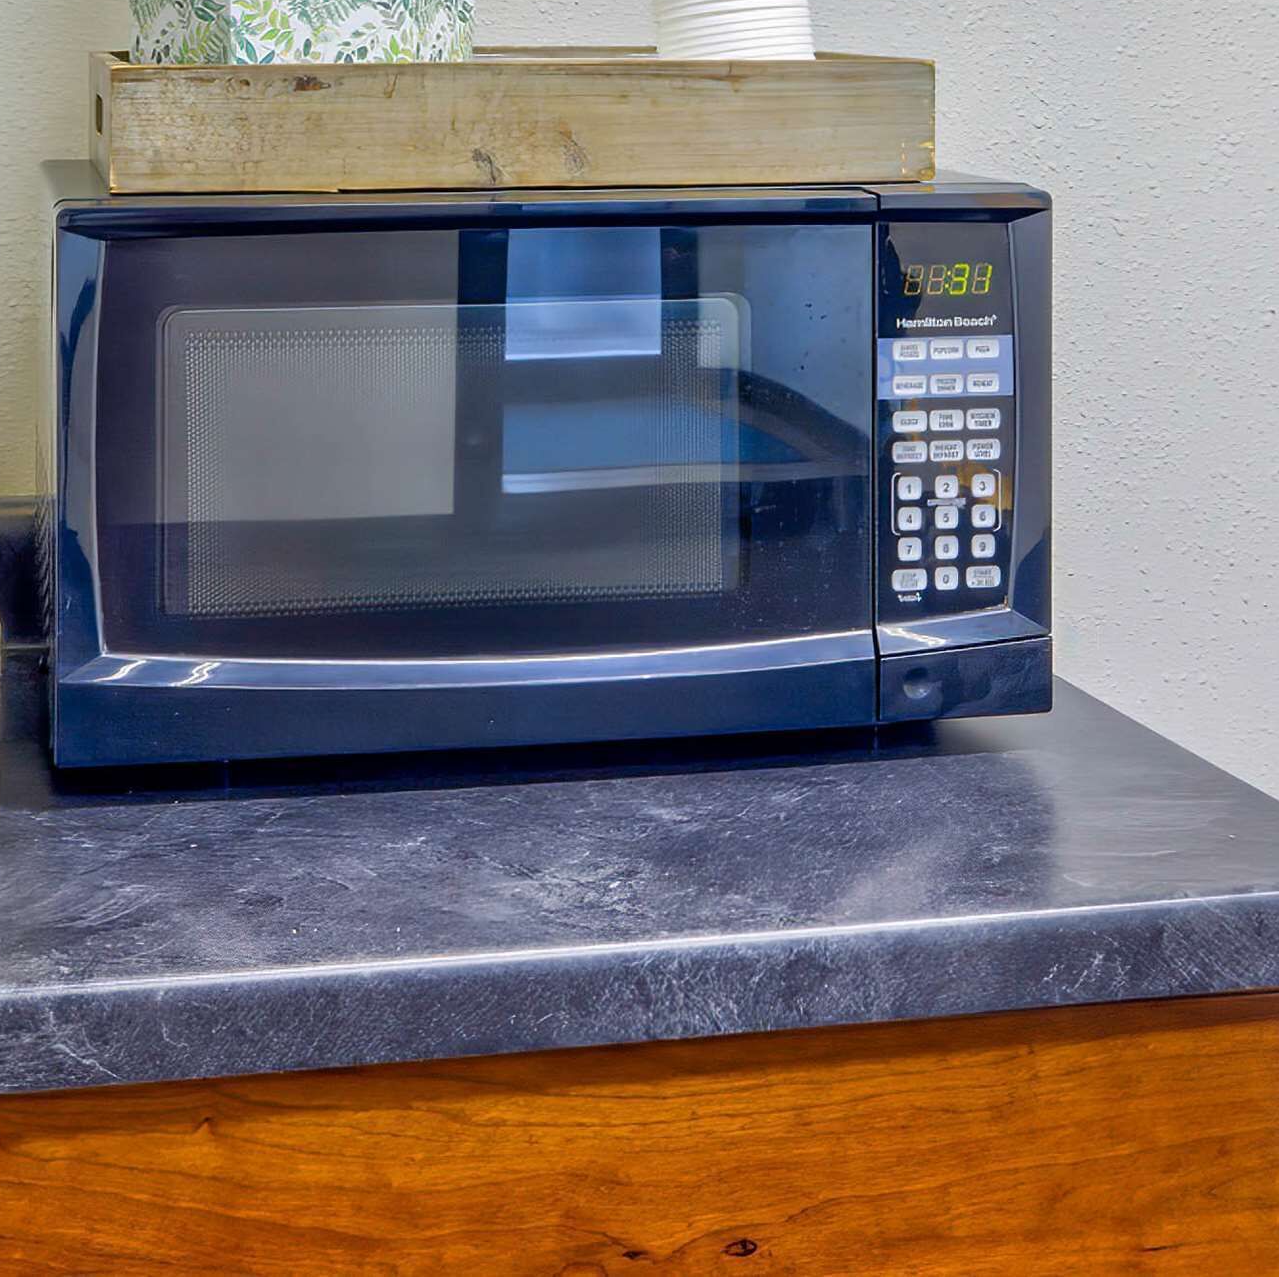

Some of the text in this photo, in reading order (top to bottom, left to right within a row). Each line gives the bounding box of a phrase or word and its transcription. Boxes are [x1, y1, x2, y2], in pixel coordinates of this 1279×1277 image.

[896, 316, 988, 328] Hamilton Beach
[906, 484, 912, 494] 1
[943, 482, 950, 492] 2
[979, 481, 986, 491] 3
[906, 514, 912, 524] 4
[943, 513, 949, 523] 5
[979, 512, 986, 521] 6
[906, 545, 912, 555] 7
[943, 543, 949, 553] 8
[979, 542, 986, 552] 9
